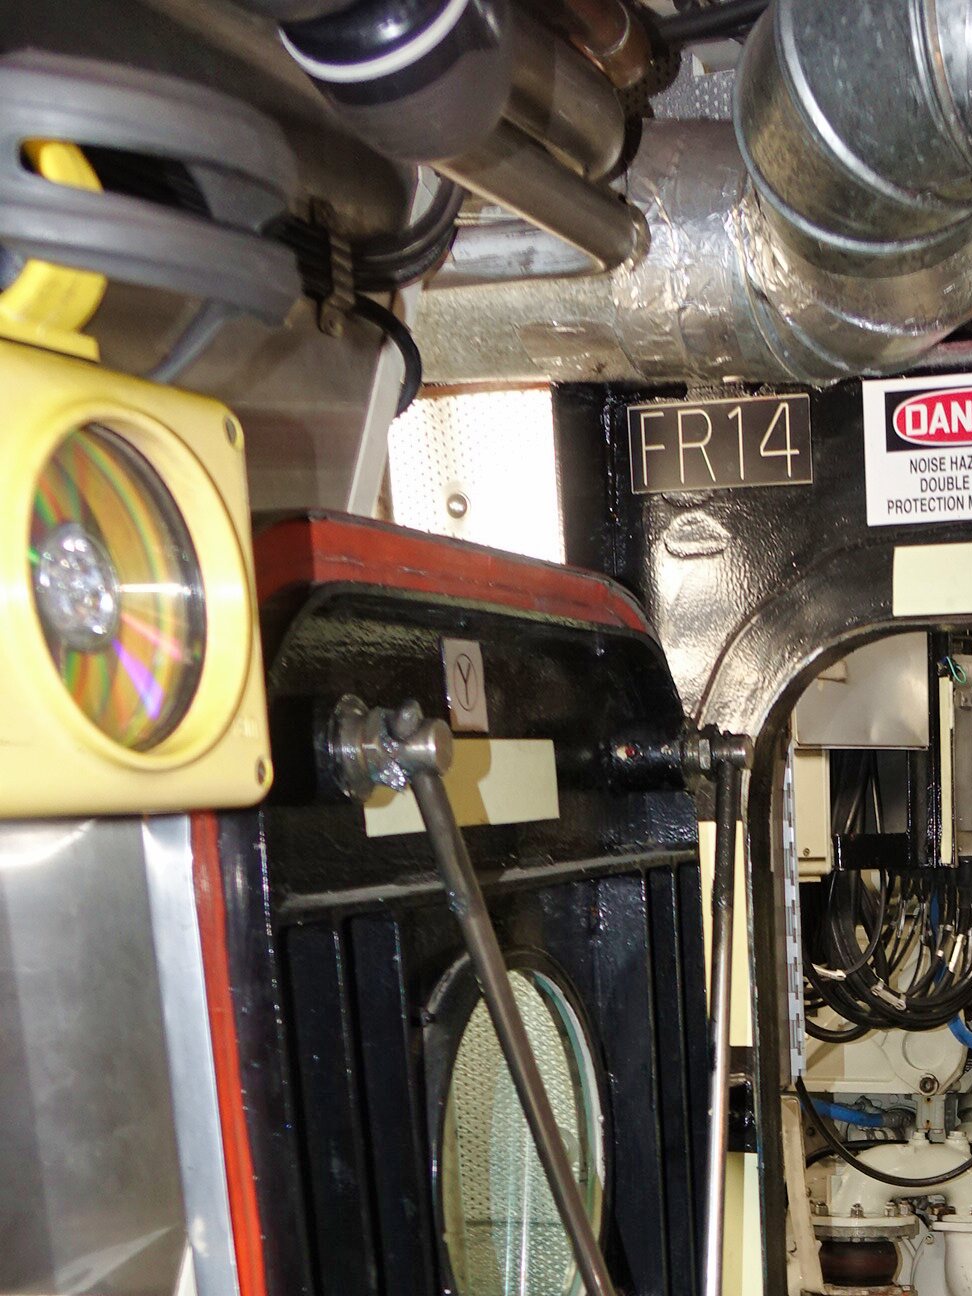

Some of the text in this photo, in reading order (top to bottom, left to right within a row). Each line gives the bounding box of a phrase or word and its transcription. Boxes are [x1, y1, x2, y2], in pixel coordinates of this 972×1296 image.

[640, 402, 800, 486] FR14
[910, 457, 946, 474] NOISE
[920, 476, 970, 493] DOUBLE
[887, 496, 966, 515] PROTECTION
